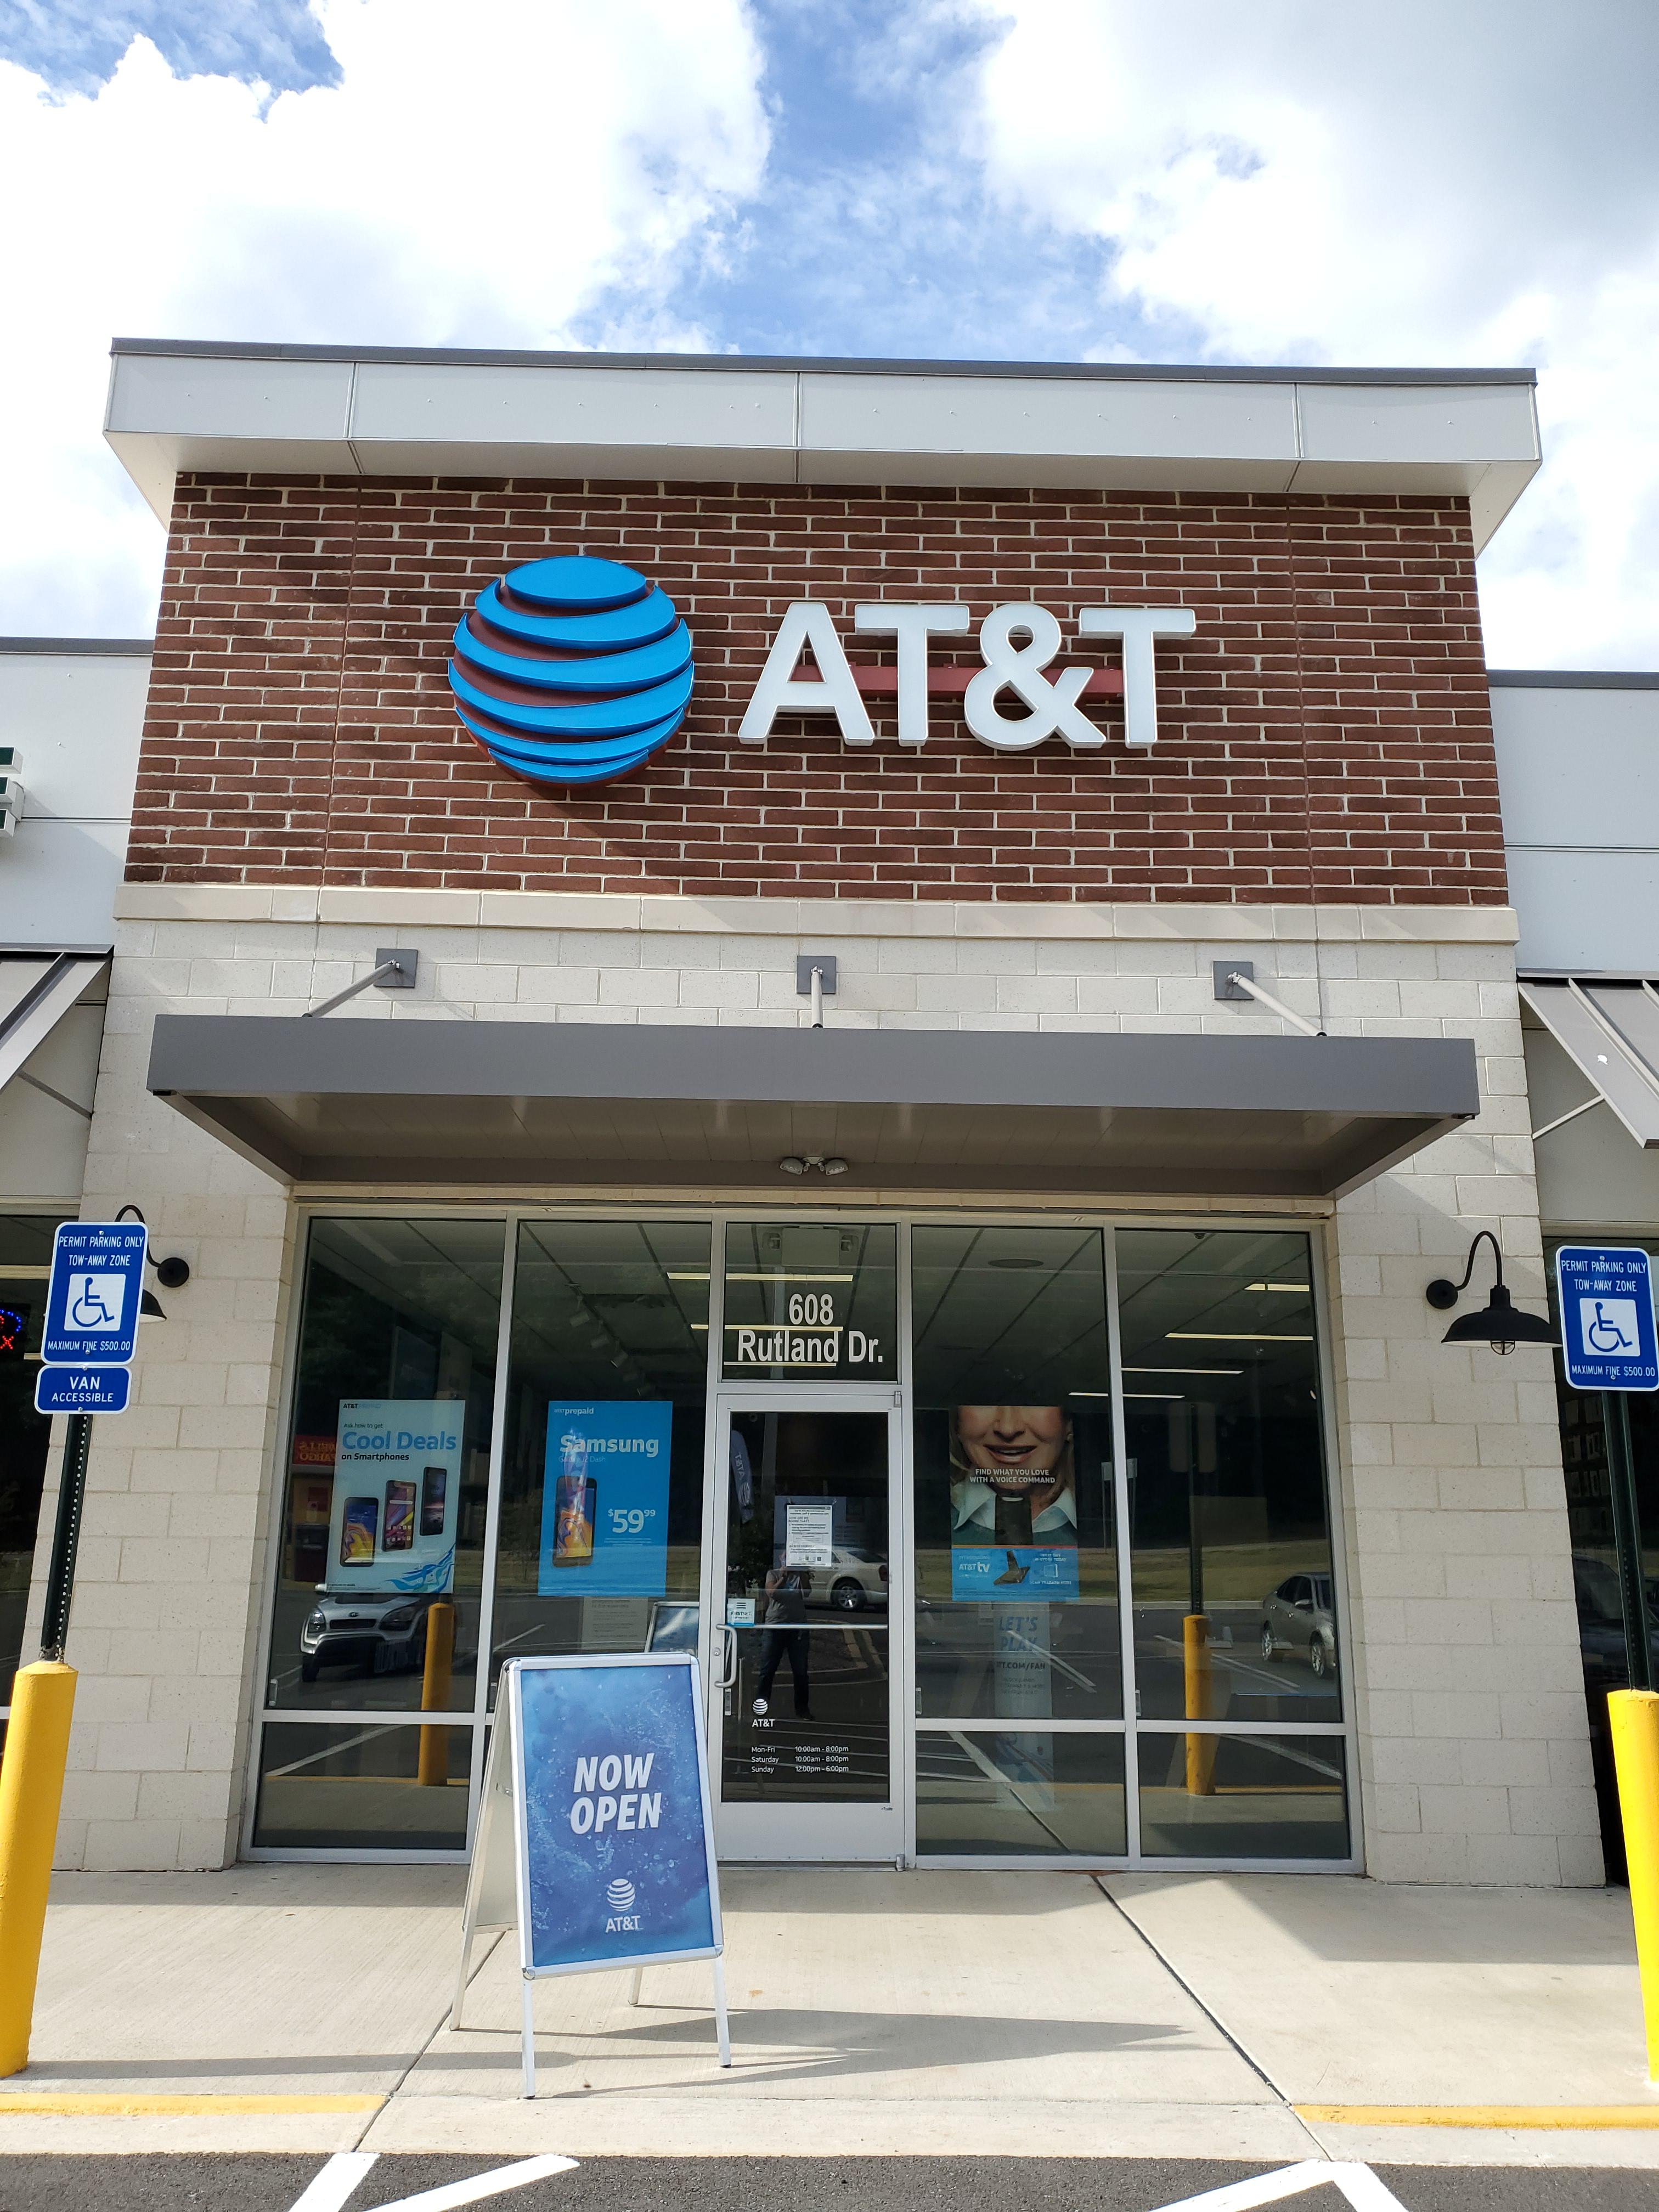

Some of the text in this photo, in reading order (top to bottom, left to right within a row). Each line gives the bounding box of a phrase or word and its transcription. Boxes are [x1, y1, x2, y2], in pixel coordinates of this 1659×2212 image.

[737, 601, 1197, 751] AT&T
[58, 1236, 144, 1248] PERMIT PARKING ONLY
[69, 1255, 131, 1266] TOW-AWAY ZONE
[1561, 1260, 1646, 1274] PERMIT PARKING ONLY
[1574, 1279, 1637, 1292] TOW-AWAY ZONE
[789, 1294, 833, 1325] 608
[48, 1341, 131, 1351] MAXIMUM FINE $500.00
[738, 1329, 883, 1363] Rutland Dr.
[1572, 1364, 1655, 1377] MAXIMUM FINE $500.00
[70, 1376, 100, 1390] VAN
[52, 1392, 114, 1403] ACCESSIBLE
[565, 1407, 594, 1416] prepaid
[342, 1431, 456, 1450] Cool Deals
[560, 1435, 658, 1458] Samsung
[354, 1453, 409, 1462] Smartphones
[977, 1562, 990, 1572] tv
[1000, 1616, 1037, 1632] LET'S
[752, 1719, 775, 1727] AT&T
[572, 1753, 654, 1793] NOW
[571, 1792, 662, 1835] OPEN
[605, 1915, 641, 1933] AT&T
